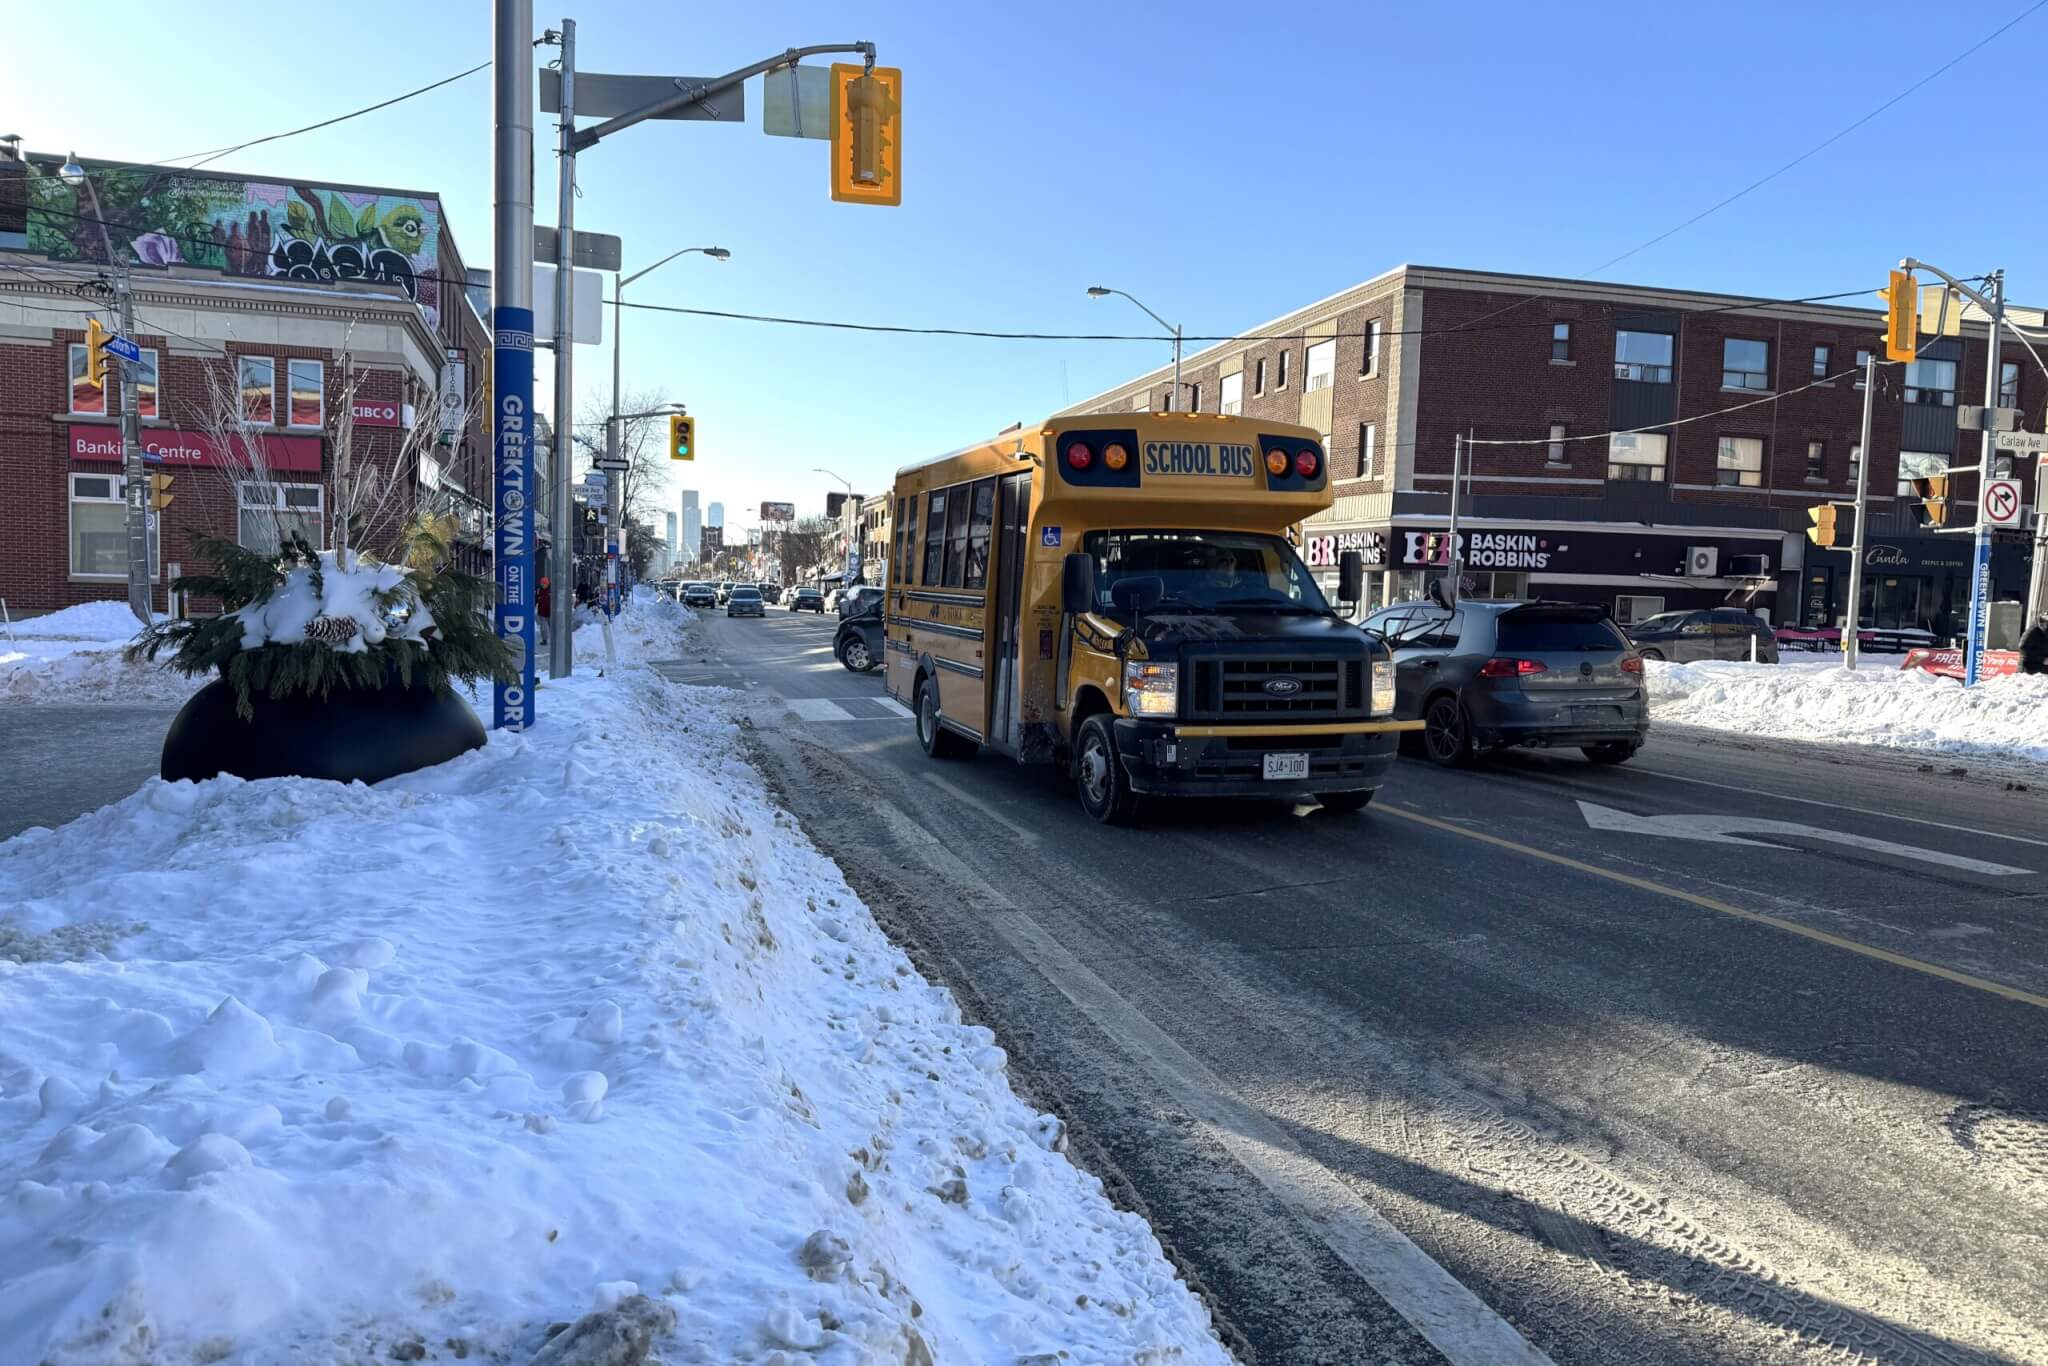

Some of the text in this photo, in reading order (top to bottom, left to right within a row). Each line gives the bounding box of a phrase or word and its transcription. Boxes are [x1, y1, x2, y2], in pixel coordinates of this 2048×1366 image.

[352, 406, 381, 418] CIBC
[76, 439, 122, 455] Banki
[146, 443, 201, 459] Centre
[2001, 435, 2041, 448] Carlaw Ave
[1146, 443, 1252, 475] SCHOOL BUS
[503, 394, 524, 556] GREEKTOWN
[1338, 532, 1375, 549] BASKIN
[1471, 534, 1537, 551] BASKIN
[1469, 551, 1548, 568] ROBBINS
[1865, 545, 1910, 566] Canela
[508, 565, 520, 605] ON THE
